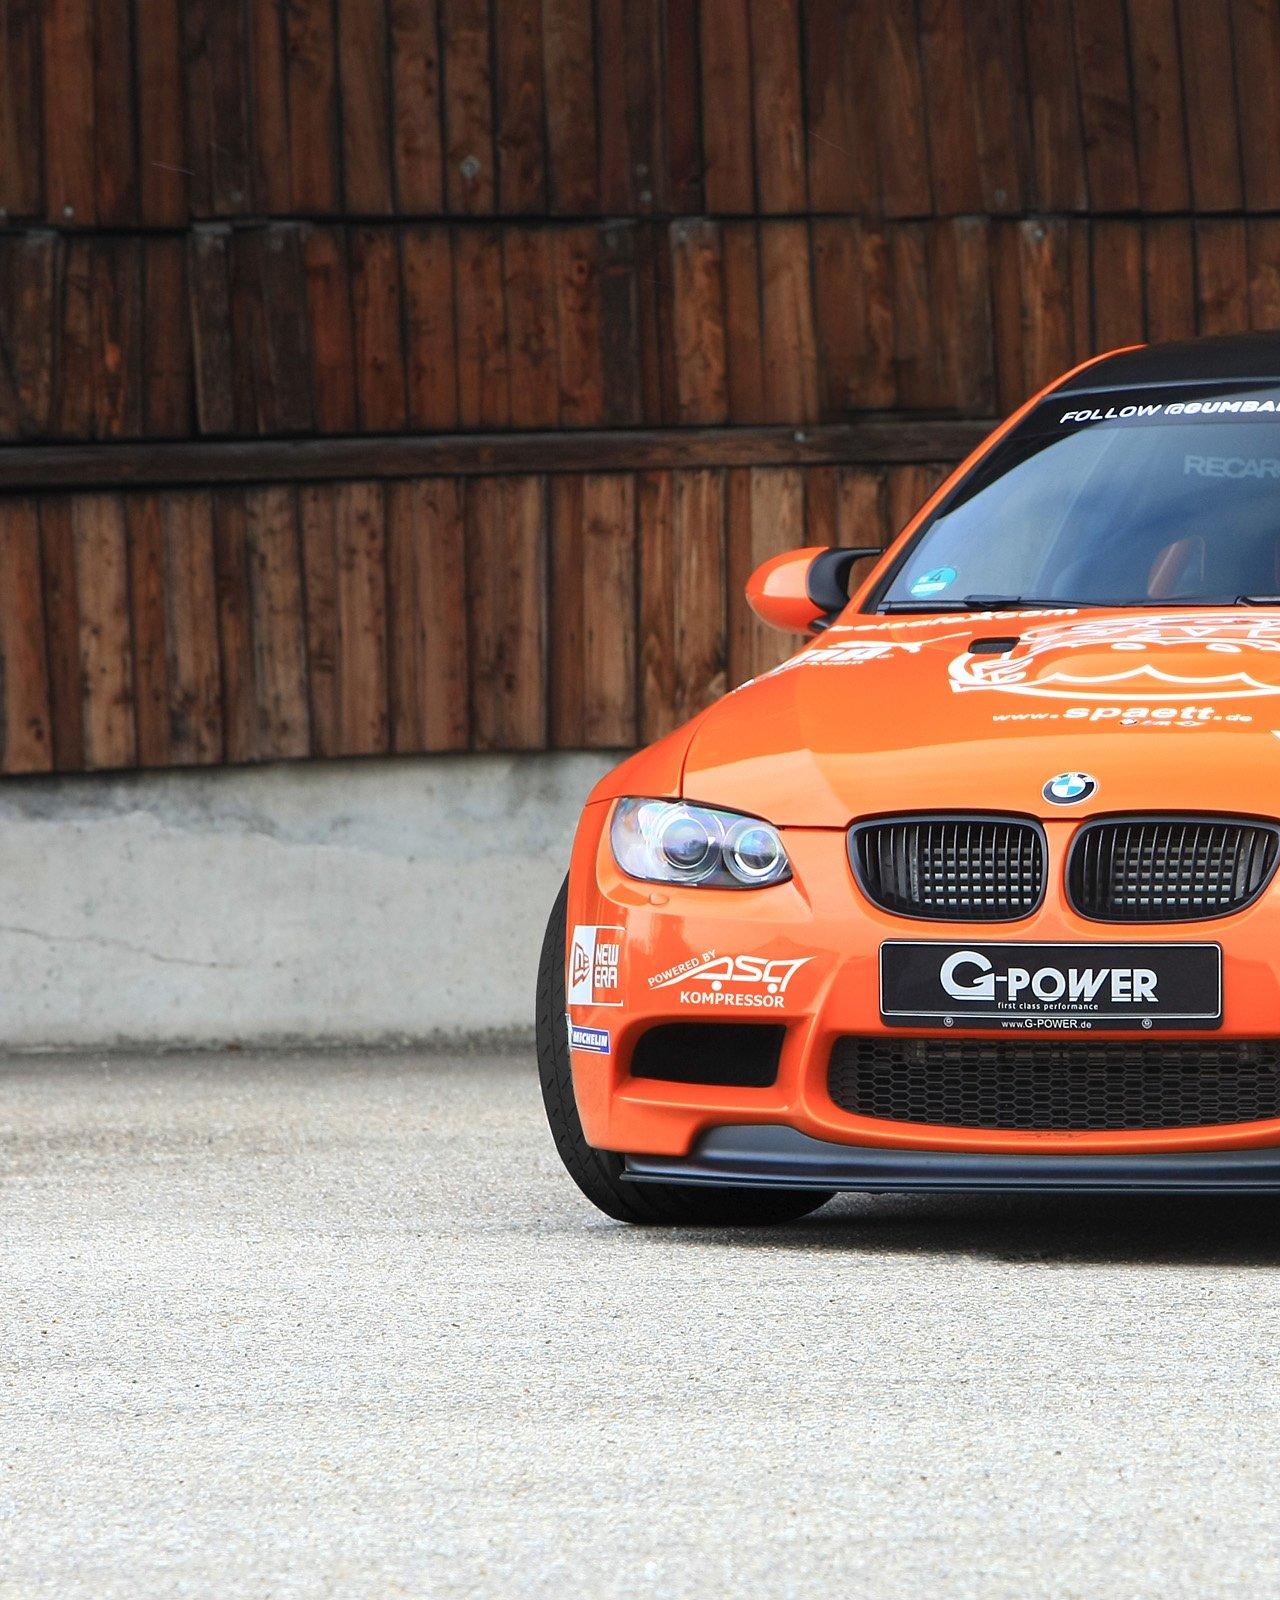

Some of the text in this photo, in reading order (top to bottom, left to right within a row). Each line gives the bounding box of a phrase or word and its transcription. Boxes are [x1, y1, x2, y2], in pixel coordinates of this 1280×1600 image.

[1060, 404, 1162, 423] FOLLOW
[993, 706, 1253, 721] www.spaett.de
[596, 944, 619, 965] NEW
[594, 966, 618, 988] ERA
[647, 949, 717, 987] POWERED BY
[940, 951, 1159, 1002] G-POWER
[680, 991, 784, 1008] KOMPRESSOR
[998, 1002, 1099, 1012] first class performance
[1001, 1018, 1092, 1029] www.G-POWER.de
[572, 1030, 608, 1047] MICHELIN
